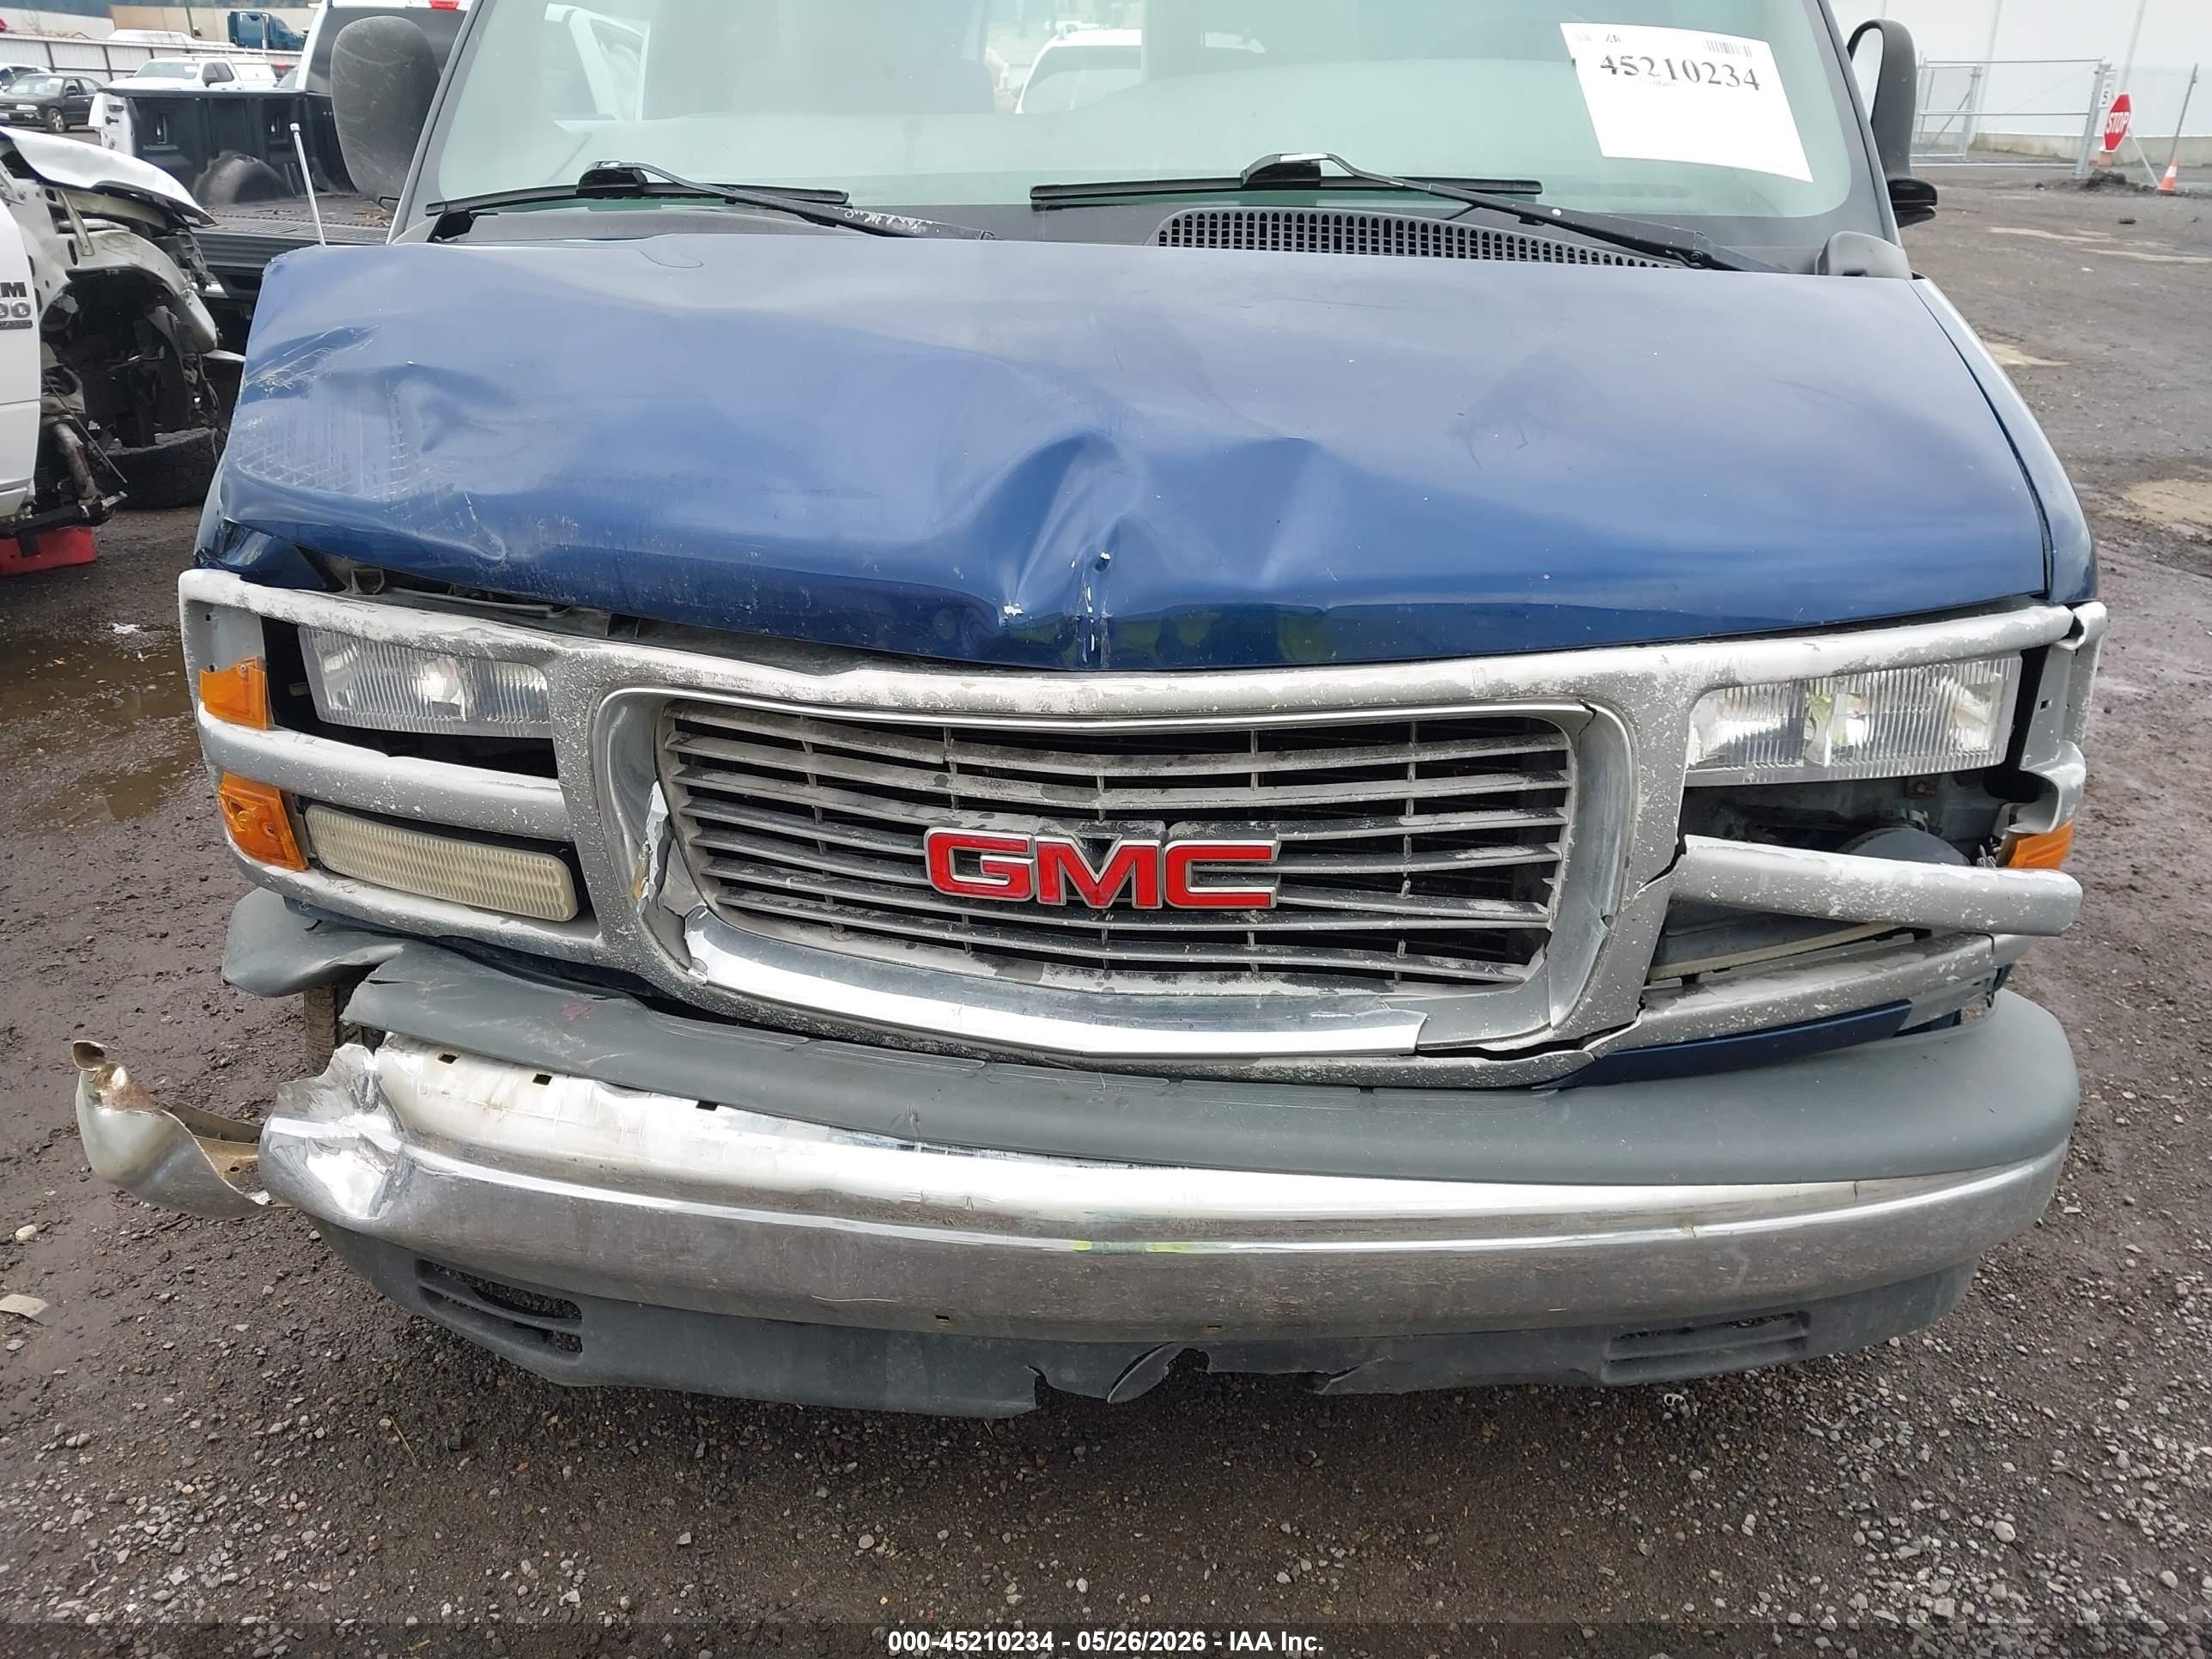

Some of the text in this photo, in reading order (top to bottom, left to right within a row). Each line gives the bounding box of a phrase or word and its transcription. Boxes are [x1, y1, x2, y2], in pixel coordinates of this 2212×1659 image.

[1601, 55, 1760, 91] 45210234
[2106, 112, 2130, 134] STOP
[924, 826, 1279, 909] GMC
